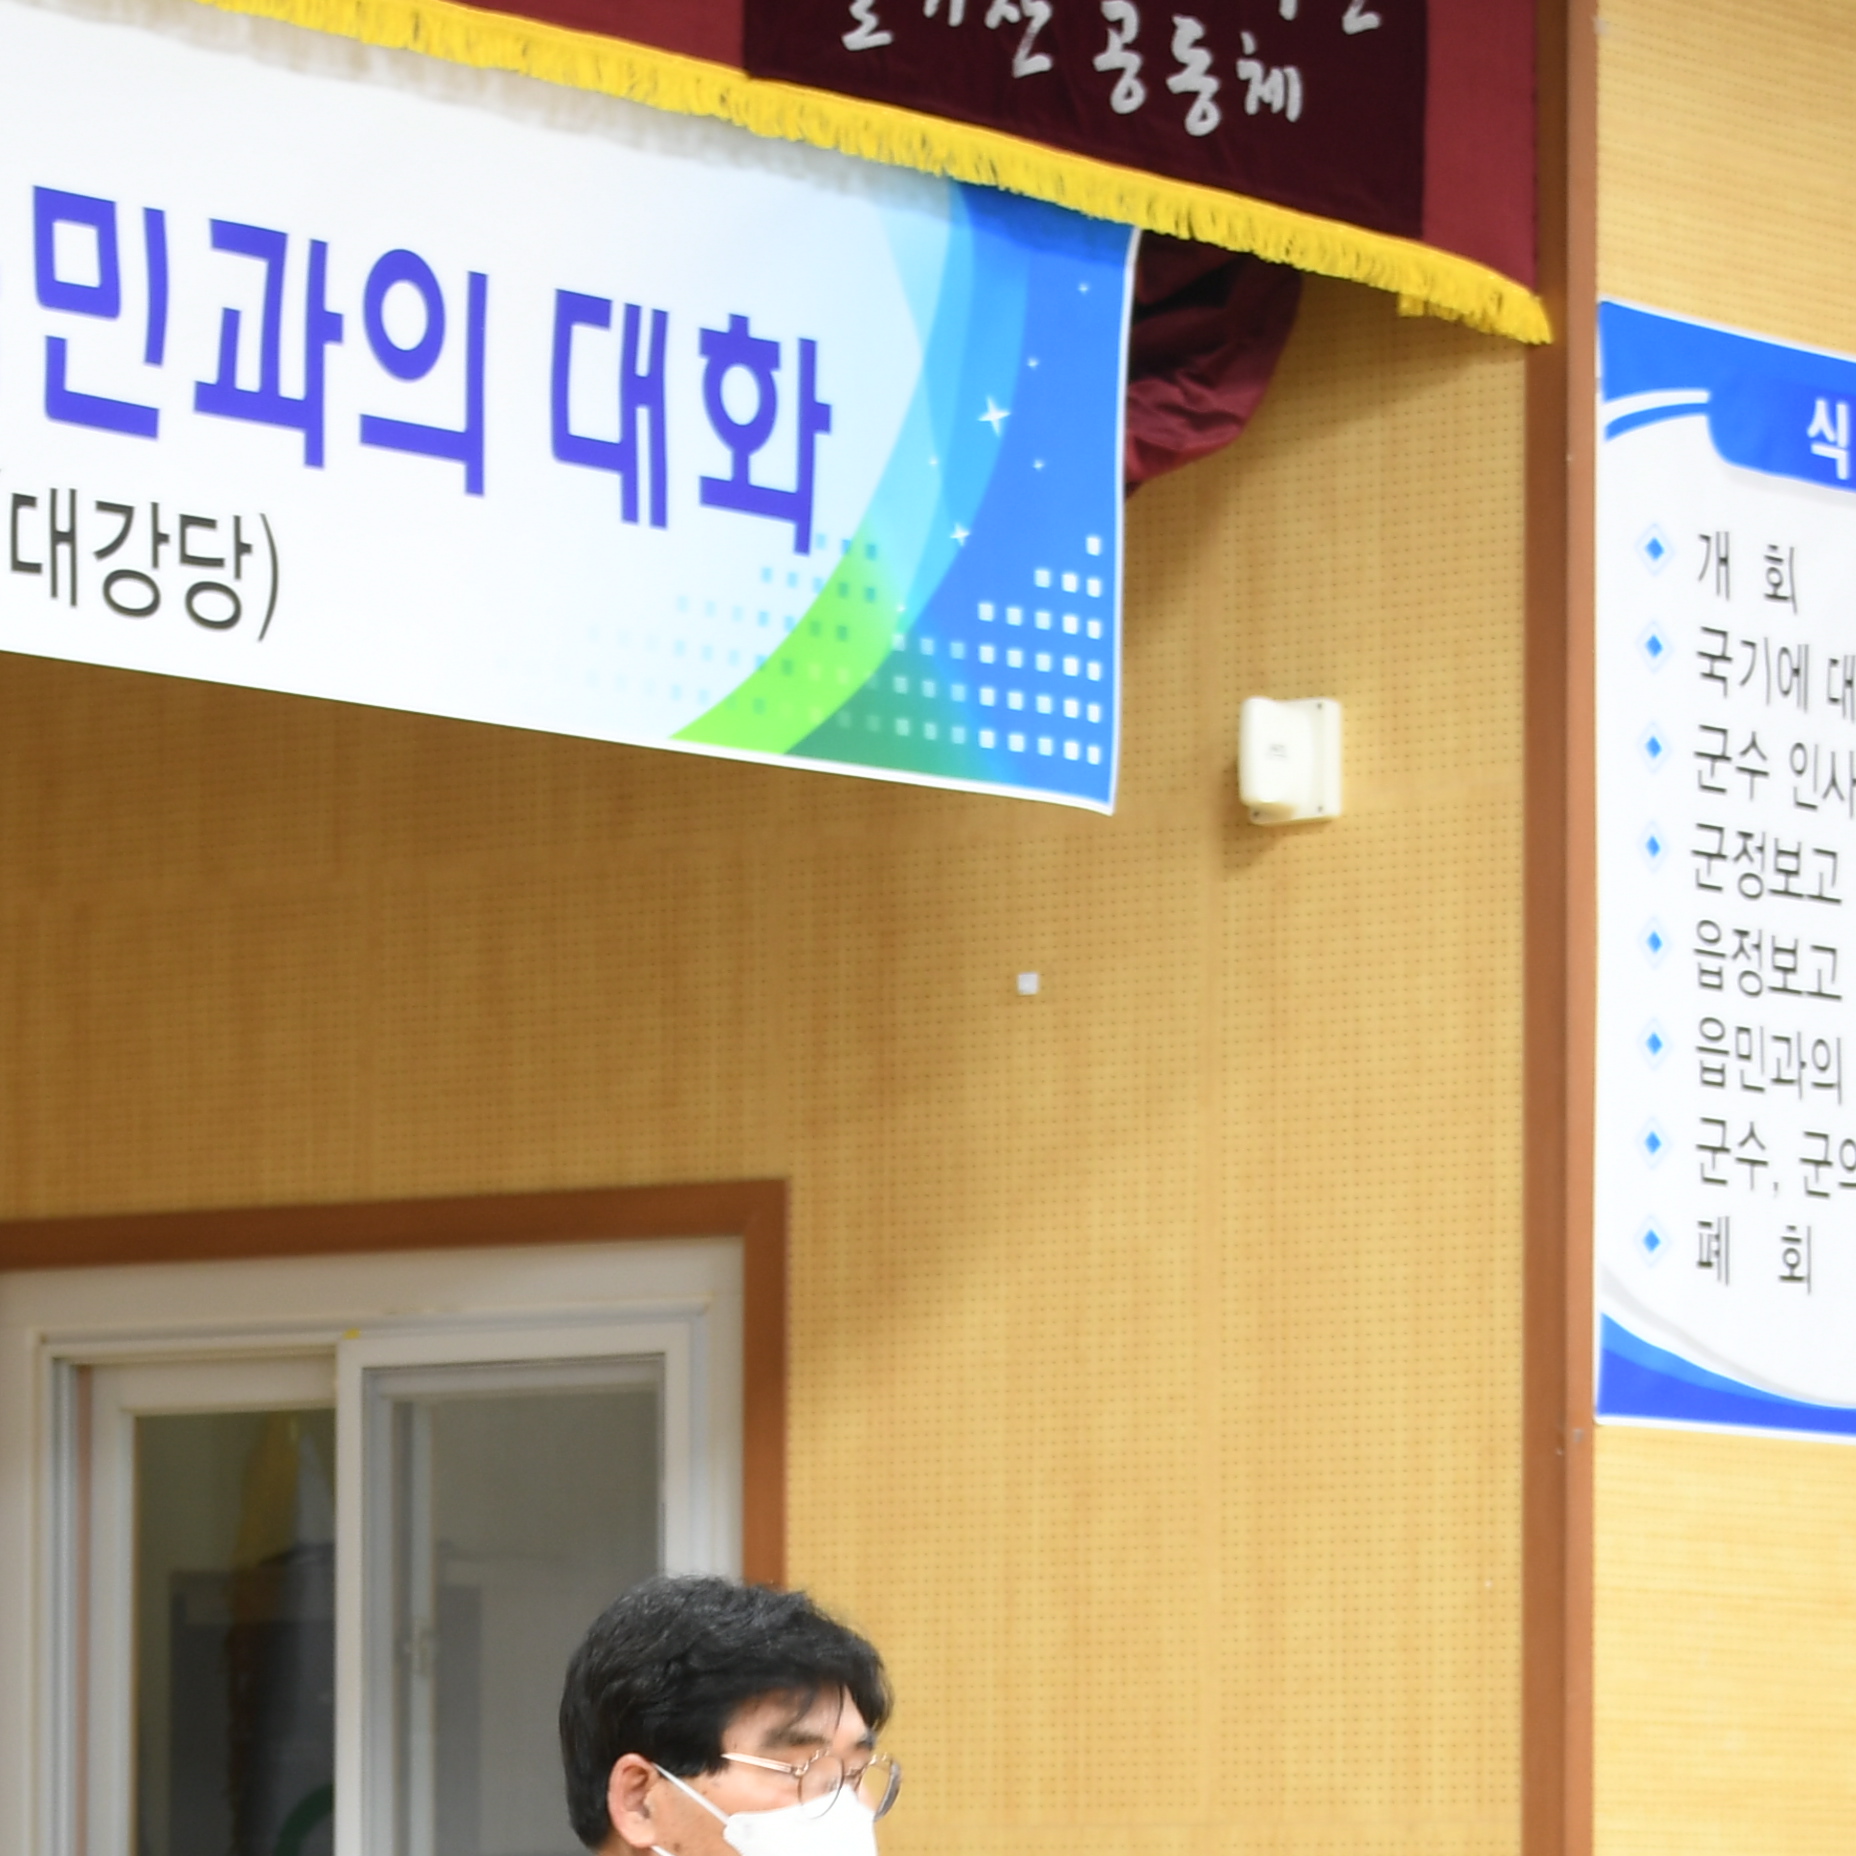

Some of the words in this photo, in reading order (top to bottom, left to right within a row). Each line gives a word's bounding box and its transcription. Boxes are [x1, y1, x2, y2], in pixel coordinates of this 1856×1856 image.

[1094, 0, 1303, 136] 공동체
[552, 290, 832, 554] 대화
[1807, 398, 1850, 480] 식
[1695, 625, 1810, 713] 국기에
[1692, 723, 1771, 801] 군수
[1690, 821, 1843, 905] 군정보고
[1693, 917, 1843, 1002] 읍정보고
[1694, 1015, 1843, 1107] 읍민과의
[1694, 1116, 1780, 1198] 군수,
